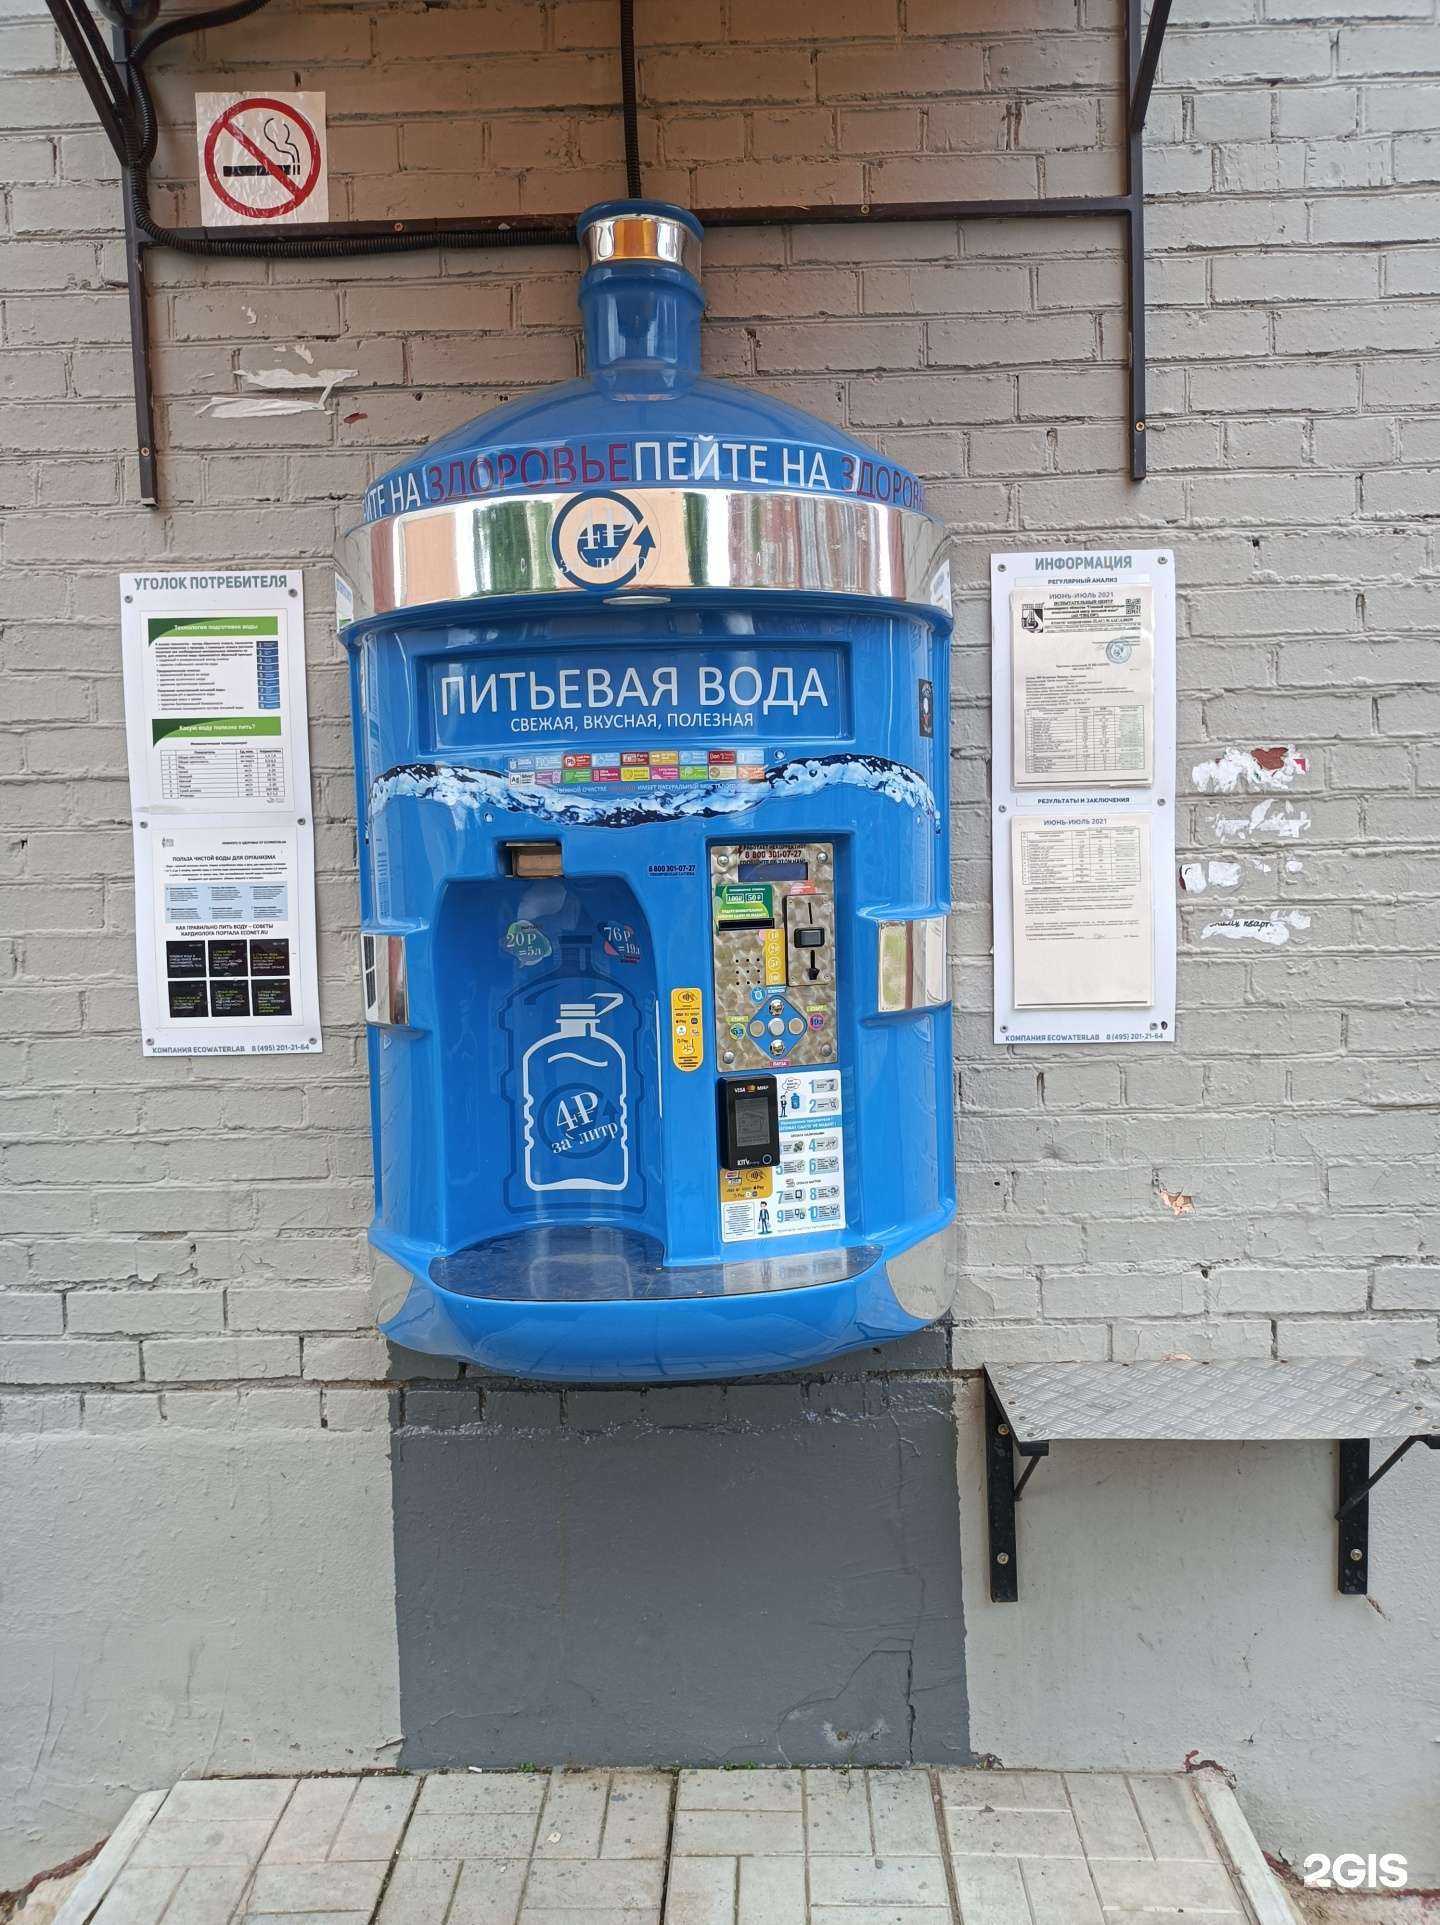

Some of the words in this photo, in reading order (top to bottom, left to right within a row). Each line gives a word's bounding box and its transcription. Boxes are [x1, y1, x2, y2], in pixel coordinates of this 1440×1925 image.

[390, 472, 422, 513] НА
[428, 443, 630, 504] ЗДОРОВЬЕ
[635, 434, 769, 484] ПЕЙТЕ
[782, 447, 831, 490] НА
[1035, 556, 1132, 571] ИНФОРМАЦИЯ
[134, 577, 187, 591] УГОЛОК
[191, 575, 287, 590] ПОТРЕБИТЕЛЯ
[440, 667, 680, 715] ПИТЬЕВАЯ
[698, 666, 829, 715] ВОДА
[510, 715, 579, 732] СВЕЖАЯ,
[583, 714, 663, 730] ВКУСНАЯ,
[667, 712, 754, 728] ПОЛЕЗНАЯ
[506, 932, 524, 948] 20
[604, 927, 622, 942] 76
[1112, 1032, 1130, 1041] (495)
[1130, 1032, 1164, 1040] 201-21-64
[193, 1045, 246, 1054] ECOWATERLAB
[257, 1044, 275, 1052] (495)
[808, 1080, 816, 1094] 1
[809, 1099, 816, 1113] 2
[552, 1138, 572, 1154] за
[579, 1122, 618, 1144] литр
[808, 1138, 816, 1152] 4
[809, 1158, 816, 1175] 6
[776, 1191, 784, 1204] 7
[810, 1188, 816, 1200] 8
[776, 1210, 784, 1222] 9
